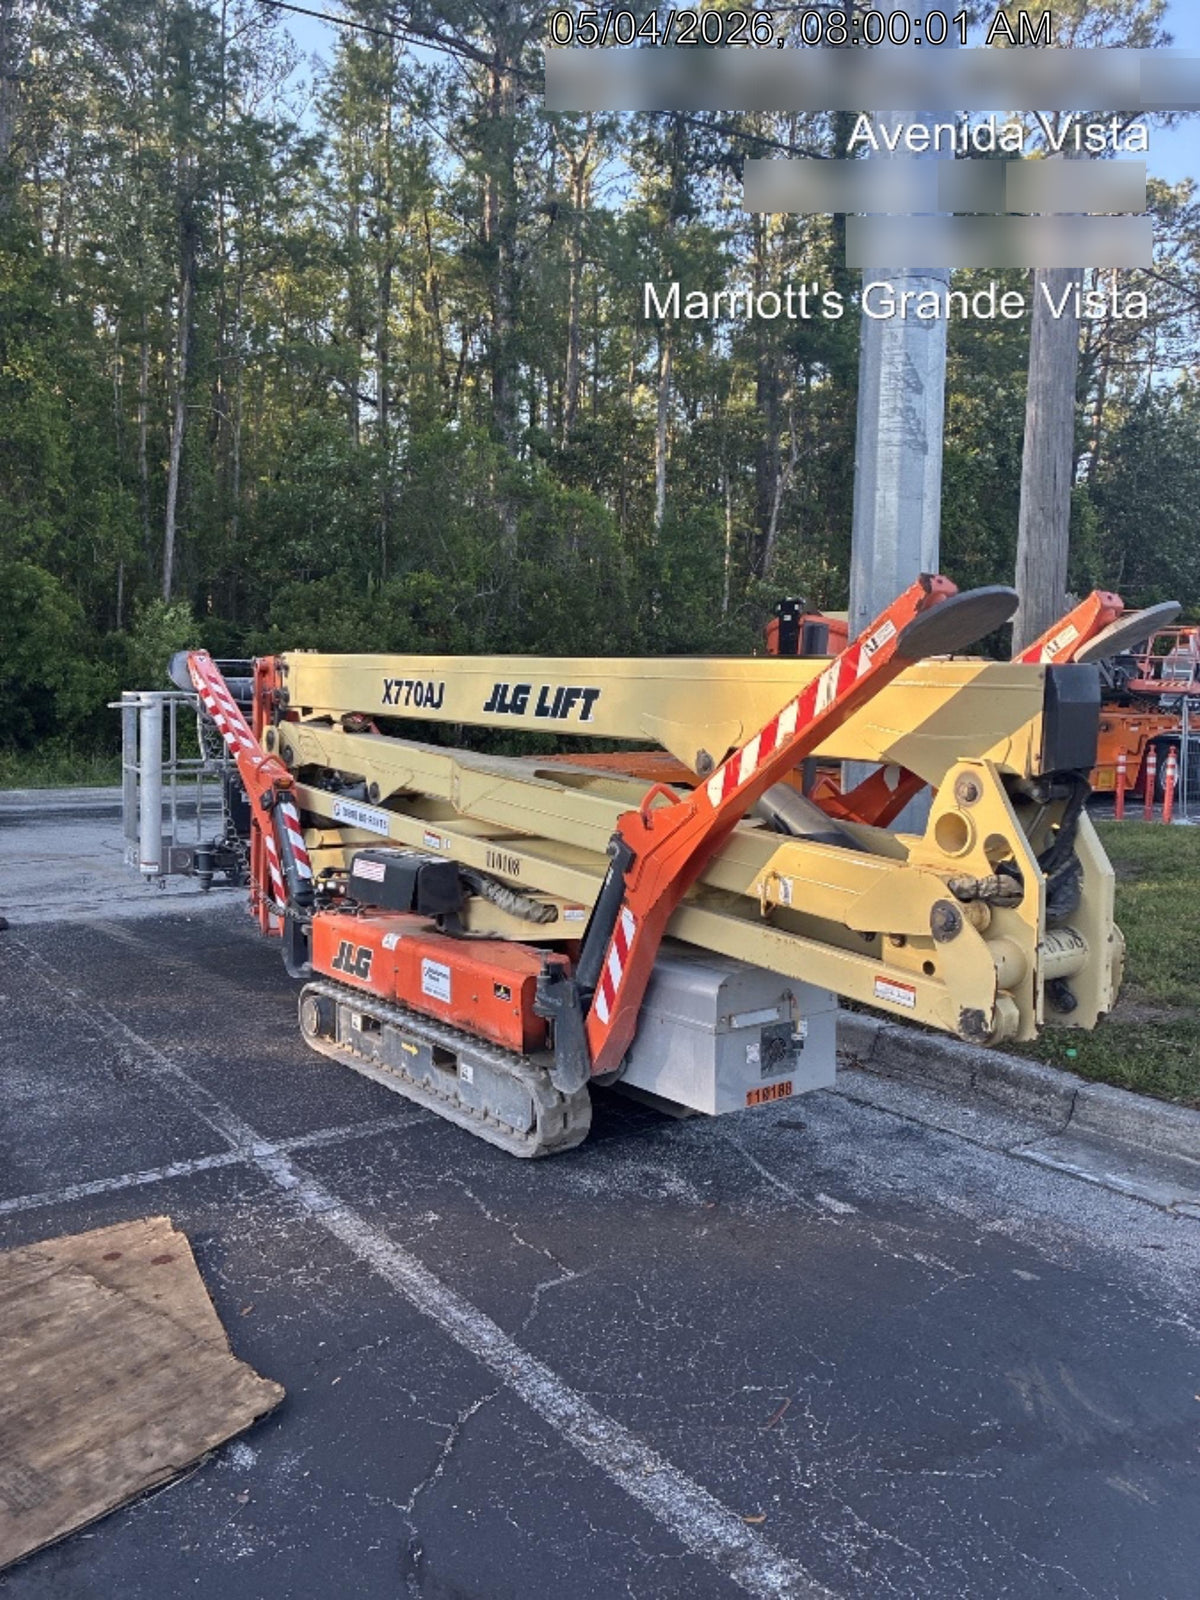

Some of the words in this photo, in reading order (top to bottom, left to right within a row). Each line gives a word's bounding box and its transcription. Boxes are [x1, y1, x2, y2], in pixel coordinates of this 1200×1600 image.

[382, 679, 446, 710] X770AJ
[483, 683, 532, 716] JLG
[534, 686, 600, 721] LIFT
[331, 940, 373, 981] JLG
